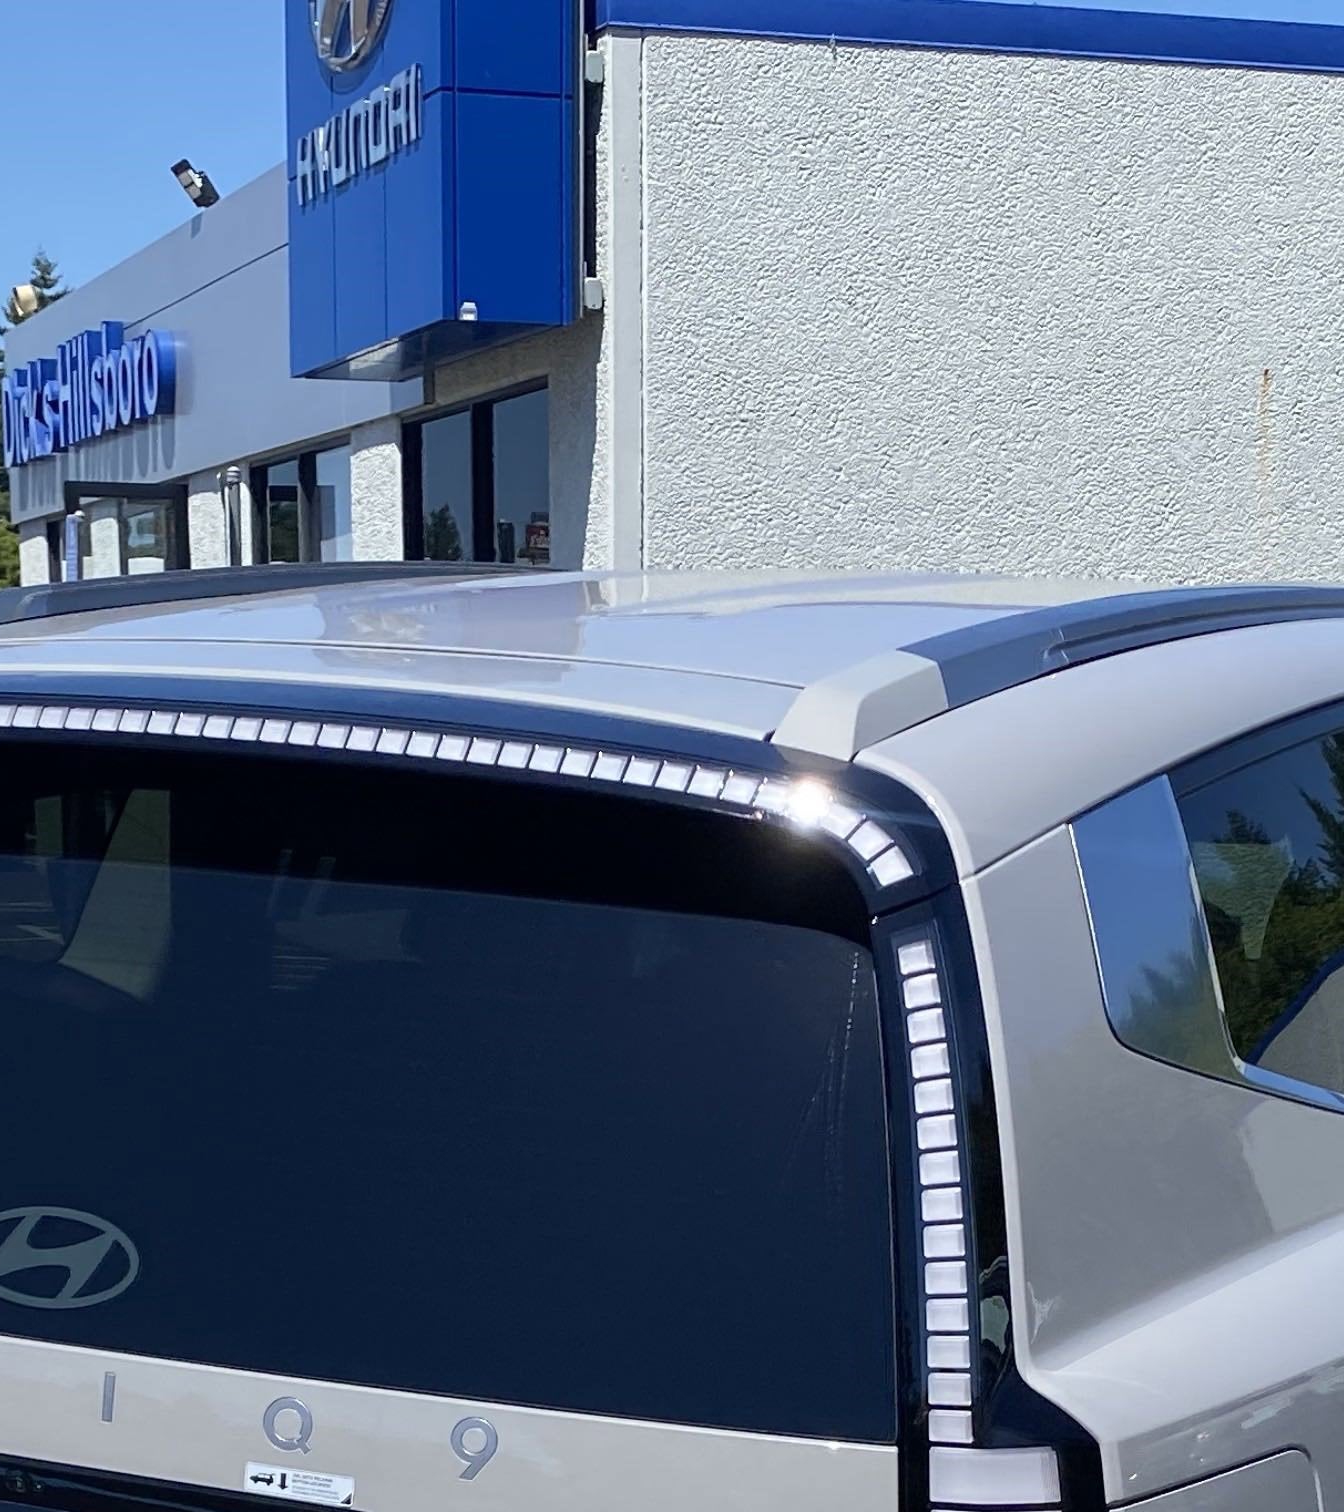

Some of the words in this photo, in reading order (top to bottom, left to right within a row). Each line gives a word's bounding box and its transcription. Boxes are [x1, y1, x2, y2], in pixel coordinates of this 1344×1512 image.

[297, 63, 422, 206] HYUNDAI
[2, 358, 55, 468] Dick's
[56, 321, 159, 448] Hillsboro
[450, 1415, 499, 1482] 9
